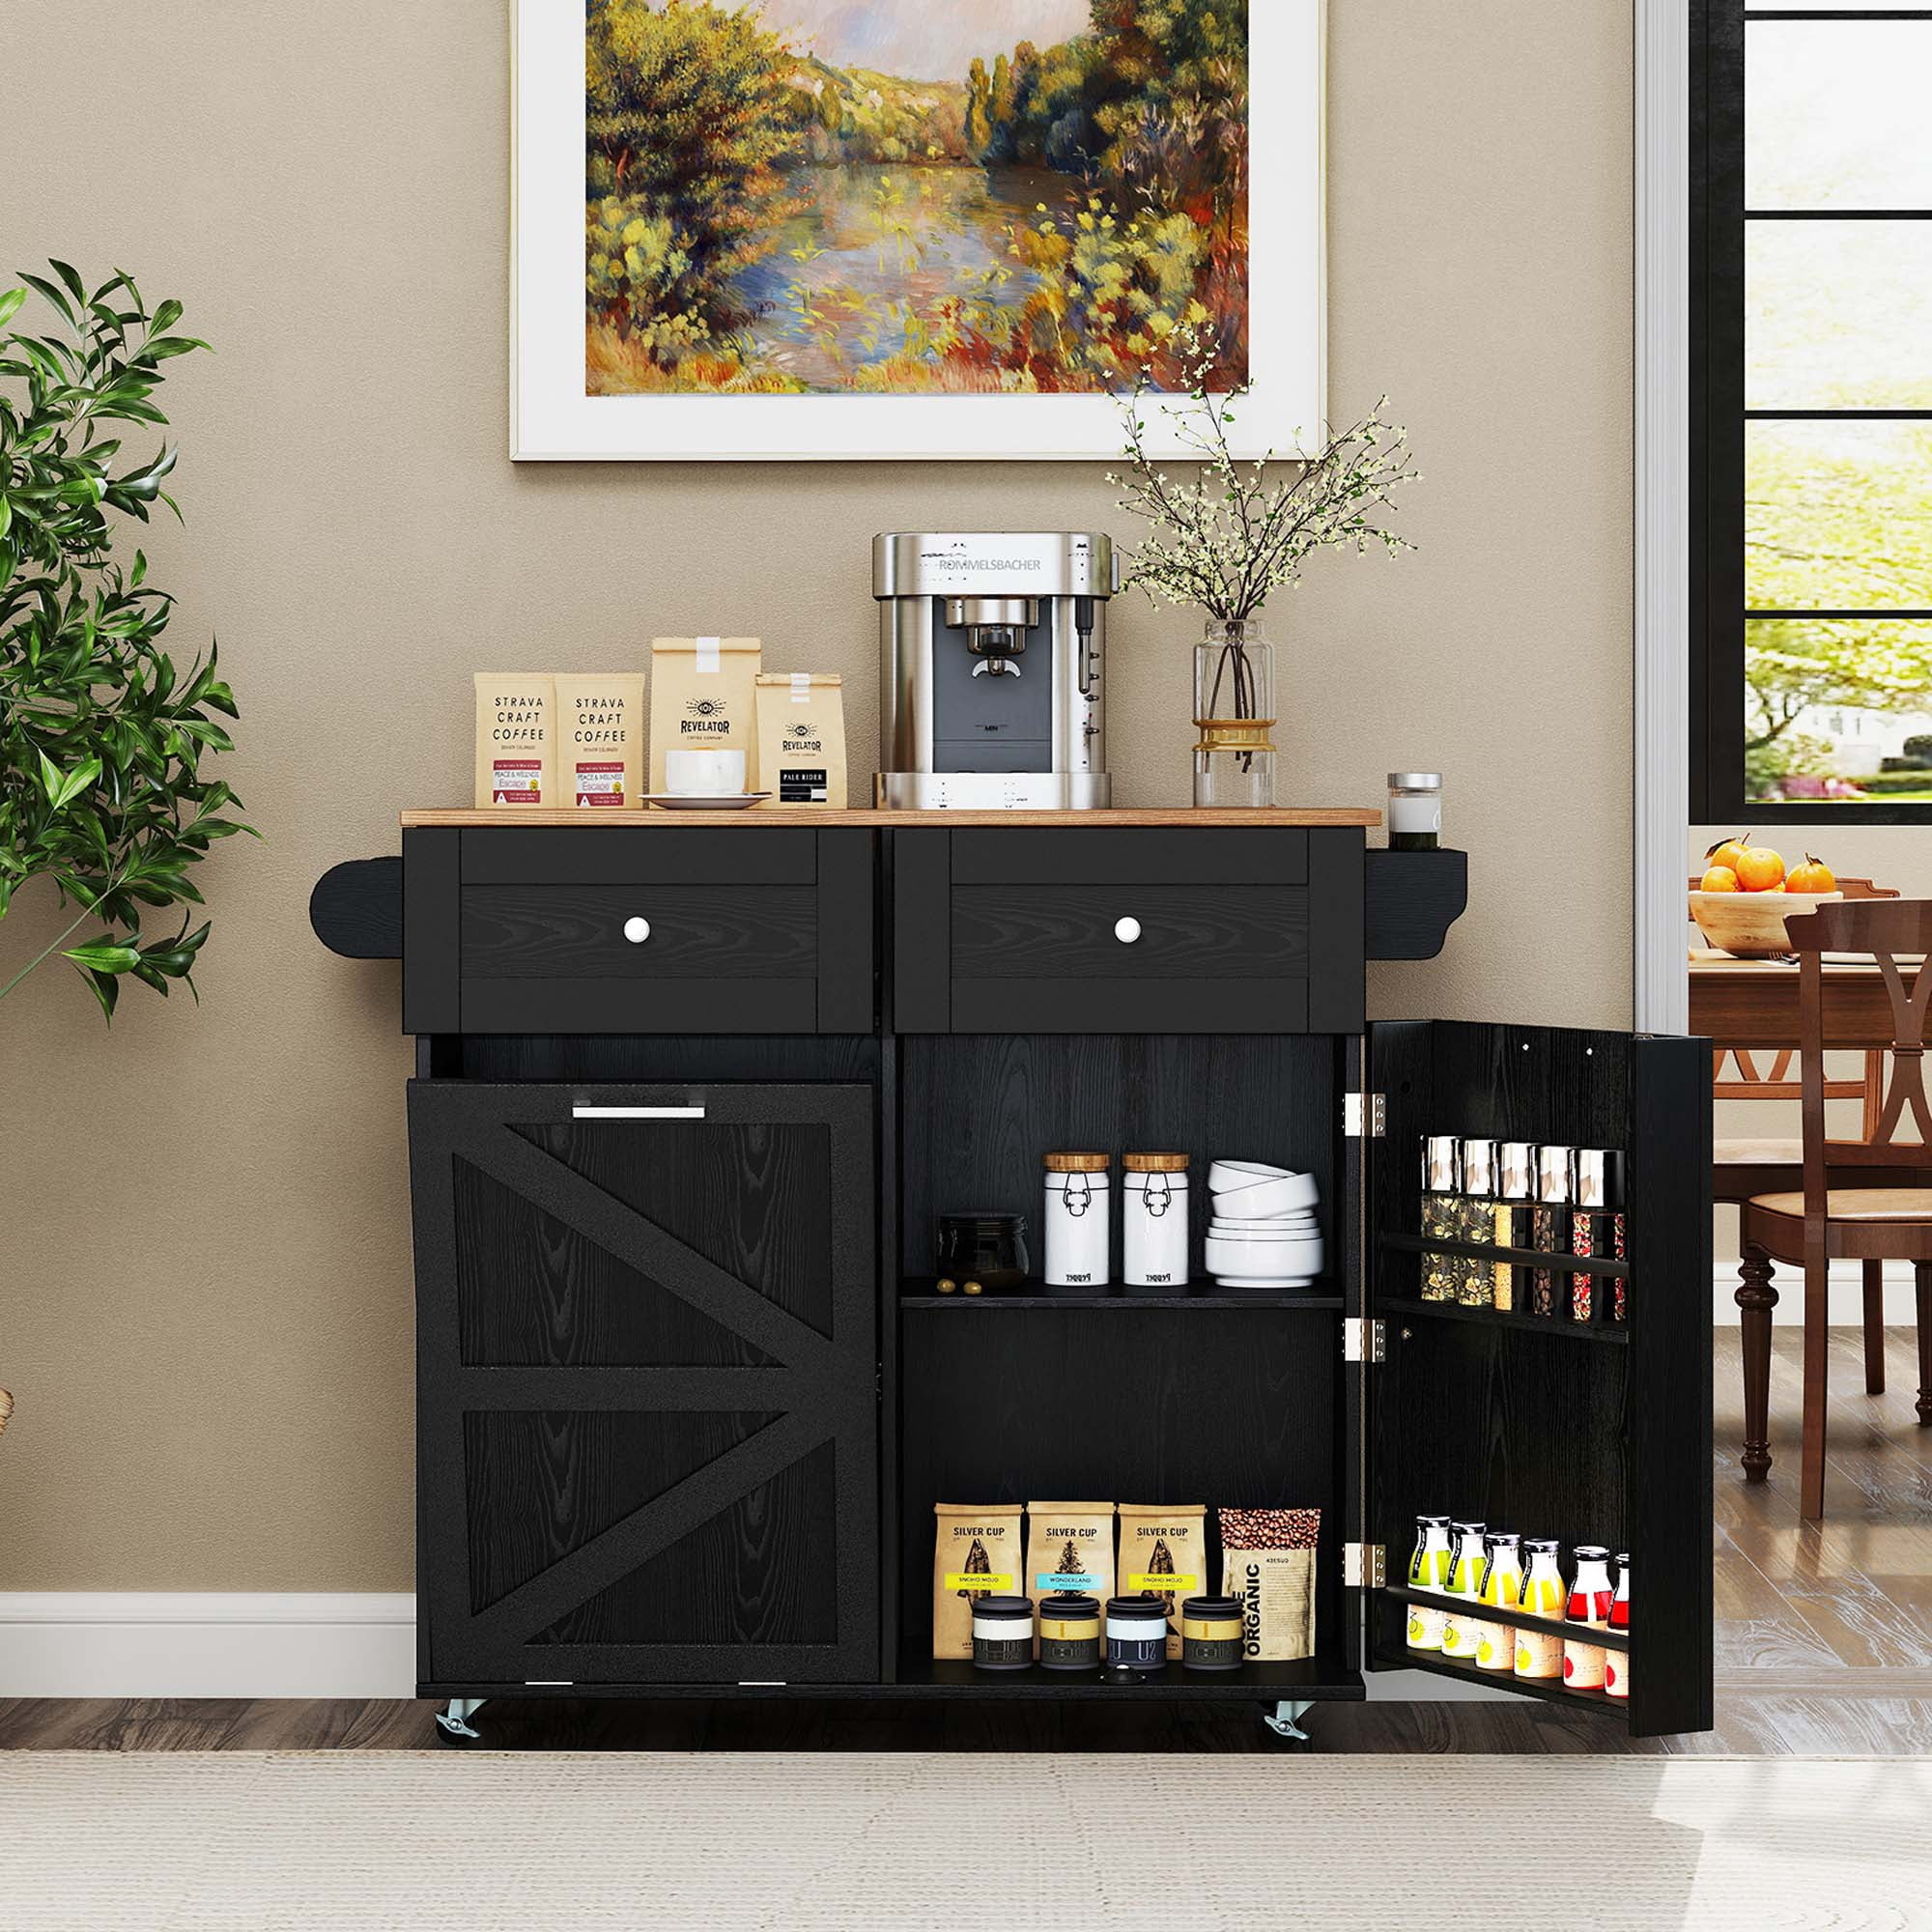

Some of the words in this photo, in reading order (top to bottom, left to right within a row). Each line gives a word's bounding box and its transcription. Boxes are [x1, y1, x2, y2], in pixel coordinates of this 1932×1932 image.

[939, 559, 1040, 571] ROMMELSBACHER
[495, 696, 543, 707] STRAVA
[576, 697, 625, 709] STRAVA
[497, 712, 540, 723] CRAFT
[579, 713, 621, 724] CRAFT
[680, 720, 730, 734] REVELATOR
[493, 728, 544, 740] COFFEE
[575, 730, 626, 743] COFFEE
[782, 740, 822, 753] REVELATOR
[498, 779, 526, 789] Escape
[582, 781, 610, 792] Escape
[953, 1526, 984, 1536] SILVER
[986, 1526, 1005, 1536] CUP
[1046, 1527, 1076, 1537] SILVER
[1078, 1528, 1097, 1537] CUP
[1136, 1527, 1167, 1537] SILVER
[1169, 1527, 1188, 1537] CUP
[1246, 1563, 1261, 1656] ORGANIC
